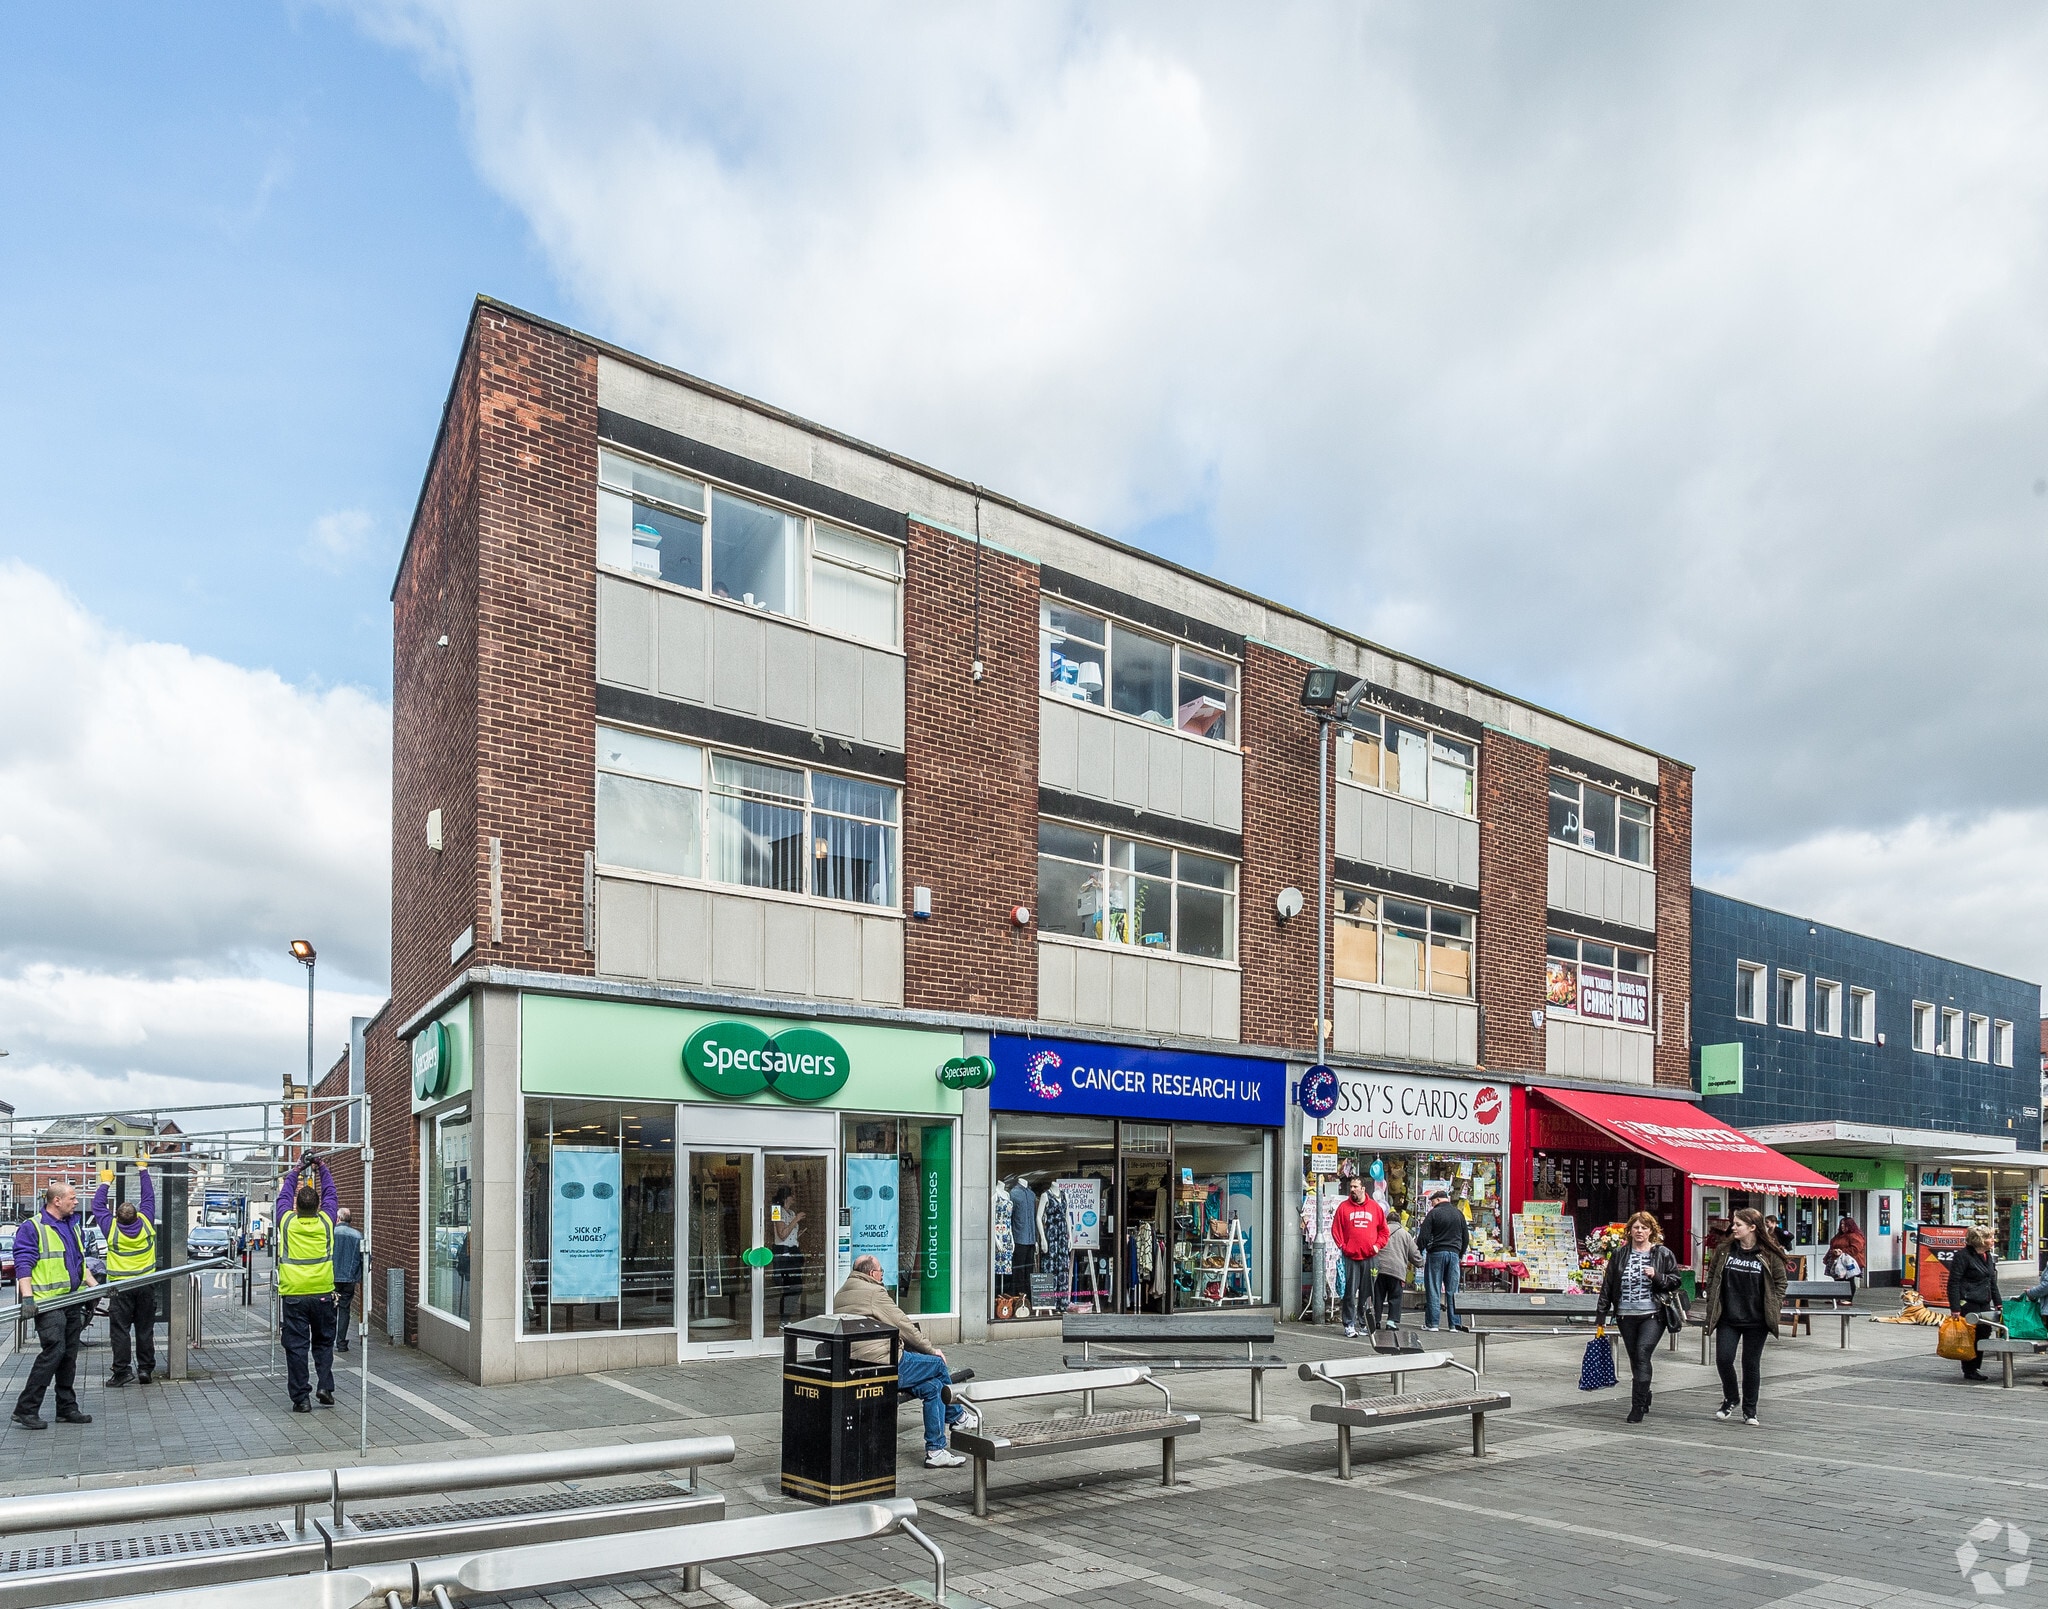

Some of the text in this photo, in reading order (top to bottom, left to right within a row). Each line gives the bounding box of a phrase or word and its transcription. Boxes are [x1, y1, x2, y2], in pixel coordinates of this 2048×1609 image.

[1617, 981, 1635, 996] RDERS
[1635, 984, 1647, 997] FOR
[703, 1040, 835, 1077] Specsavers
[944, 1064, 981, 1080] Specsavers
[1071, 1066, 1261, 1101] CANCER RESEARCH UK
[1333, 1081, 1468, 1121] SSY'S CARDS
[1353, 1119, 1374, 1138] and
[1378, 1121, 1404, 1140] Gifts
[1407, 1122, 1426, 1141] For
[1429, 1123, 1444, 1142] All
[1448, 1125, 1500, 1145] Occasions
[253, 1223, 260, 1231] P
[574, 1226, 602, 1234] SICK OF
[926, 1171, 938, 1279] Contact Lenses
[568, 1233, 607, 1242] SMUDGES?
[859, 1230, 889, 1238] SMUDGES?
[794, 1384, 820, 1399] LITTER
[856, 1385, 884, 1399] LITTER
